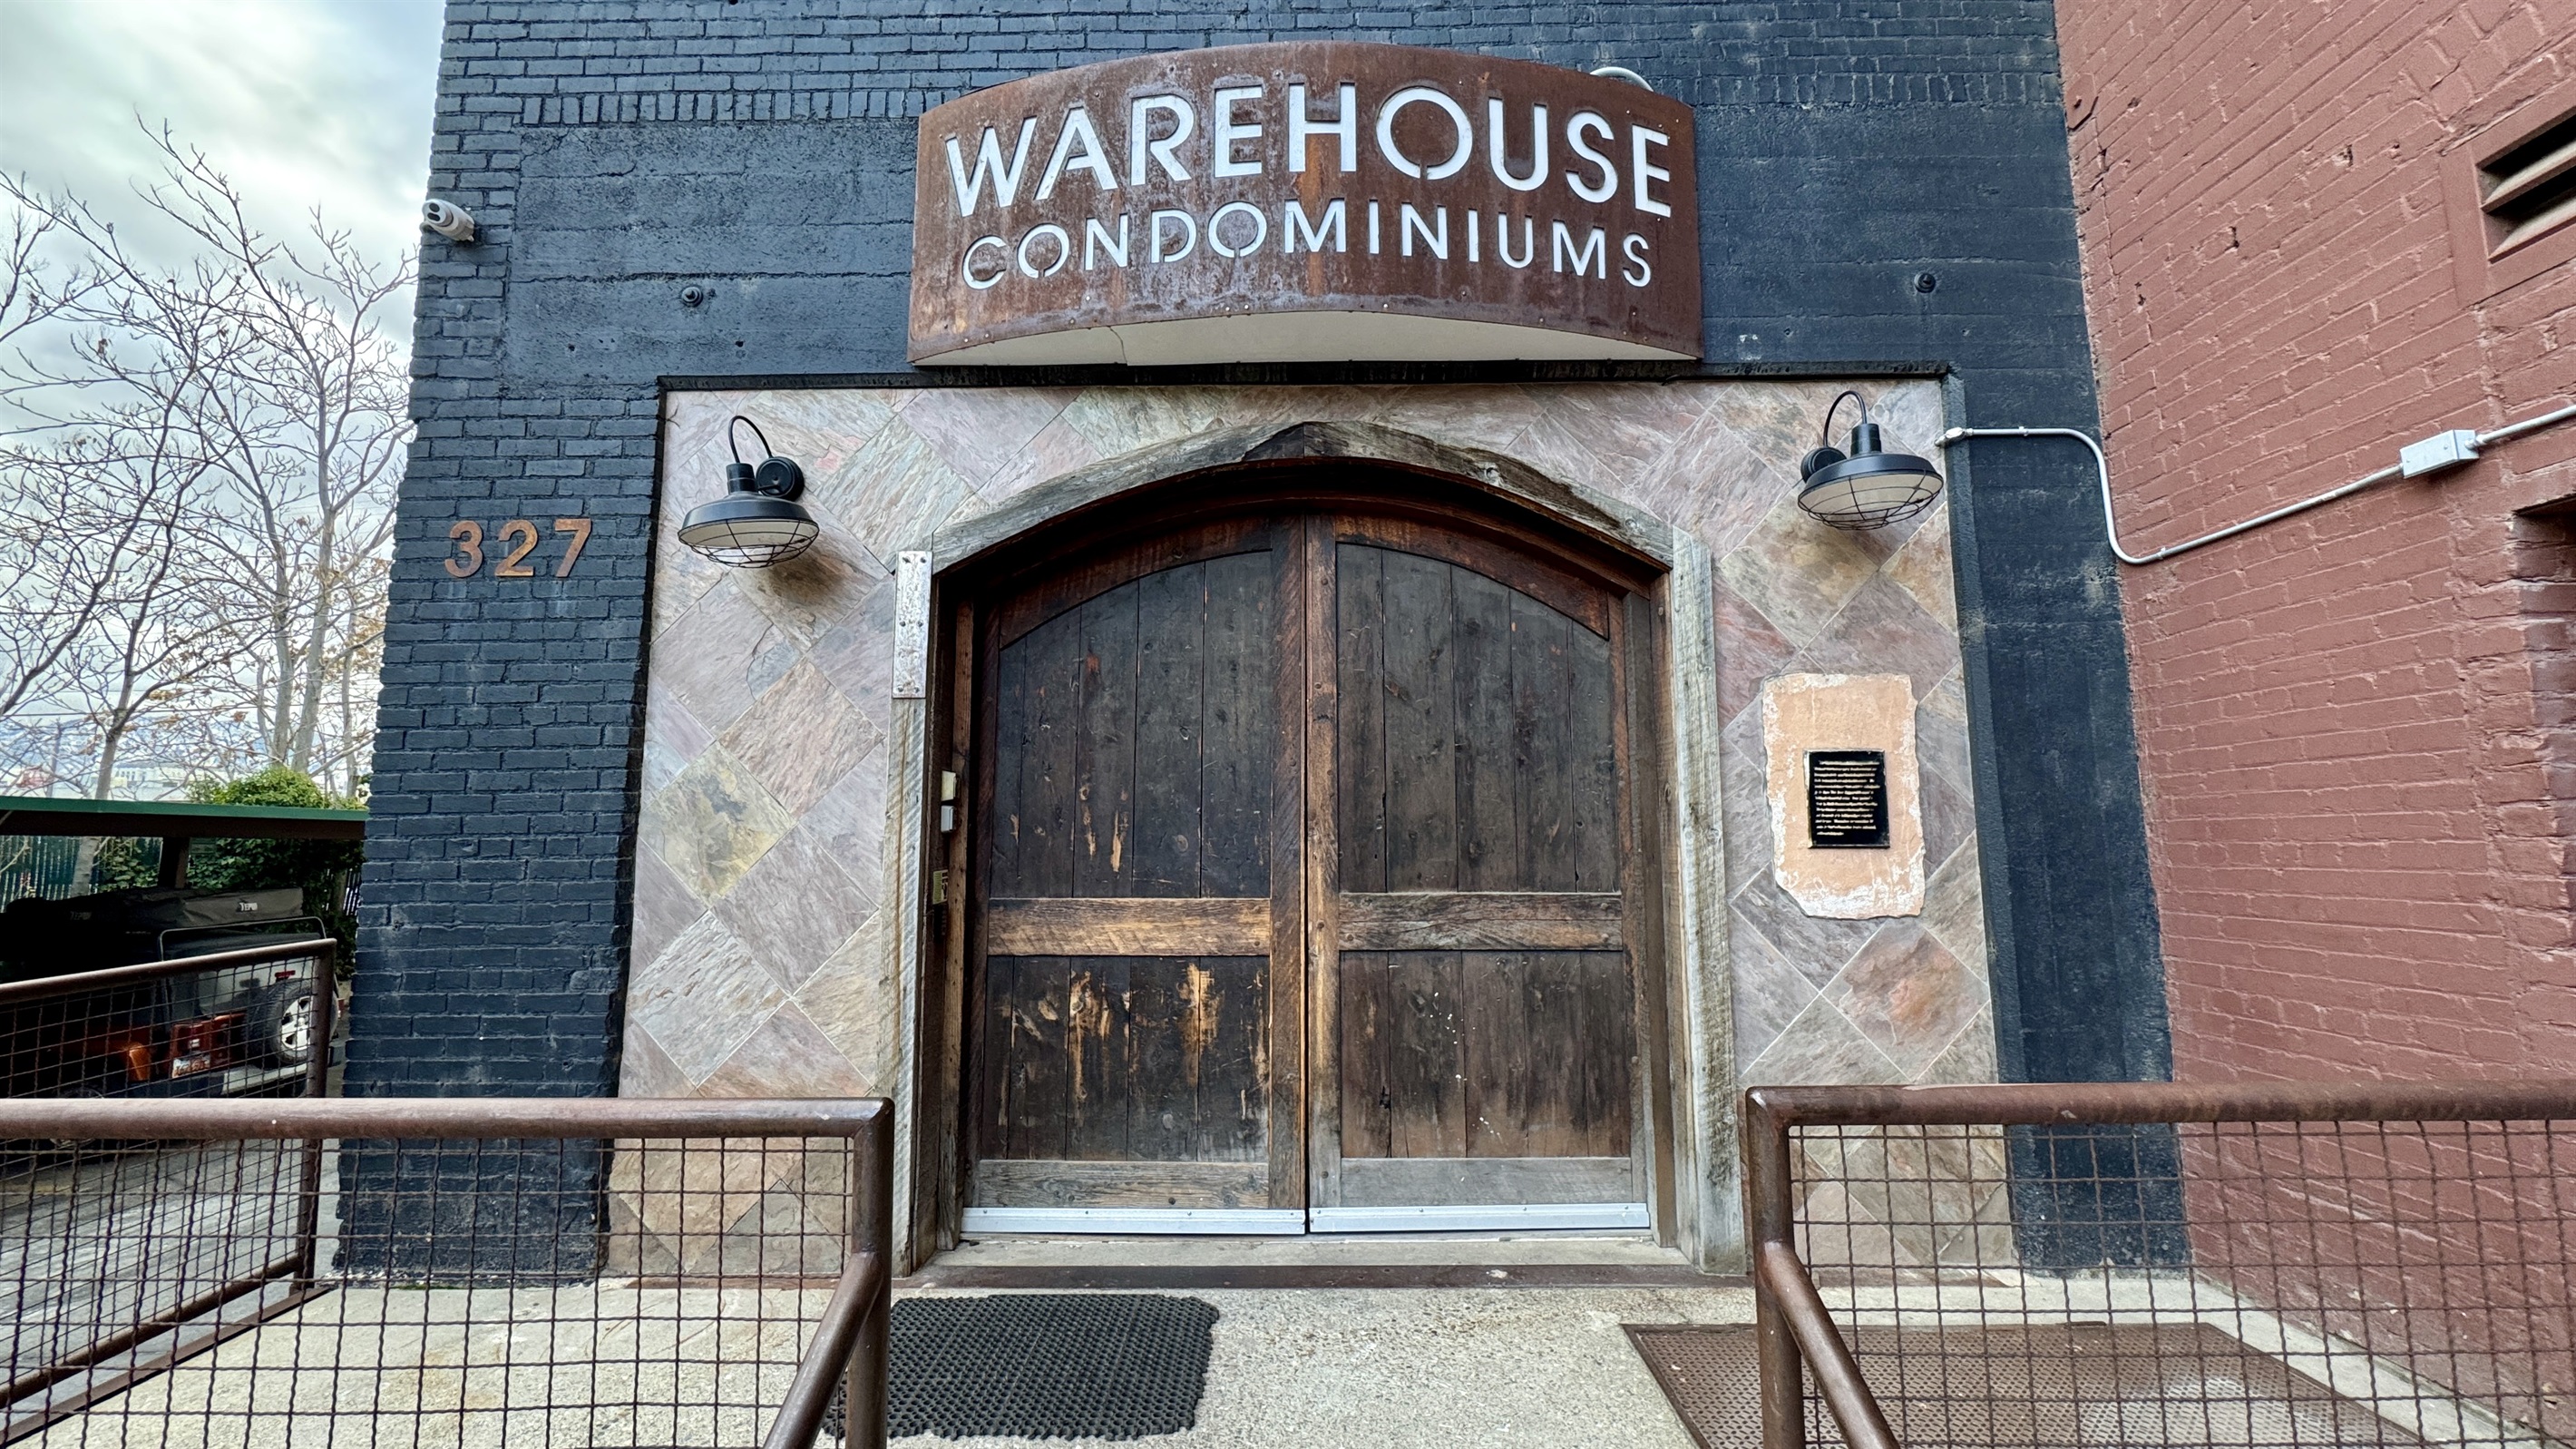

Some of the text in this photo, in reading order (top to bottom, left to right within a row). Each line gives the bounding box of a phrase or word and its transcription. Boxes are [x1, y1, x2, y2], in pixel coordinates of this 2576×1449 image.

[945, 83, 1672, 218] WAREHOUSE
[962, 198, 1652, 290] CONDOMINIUMS
[444, 518, 592, 578] 327
